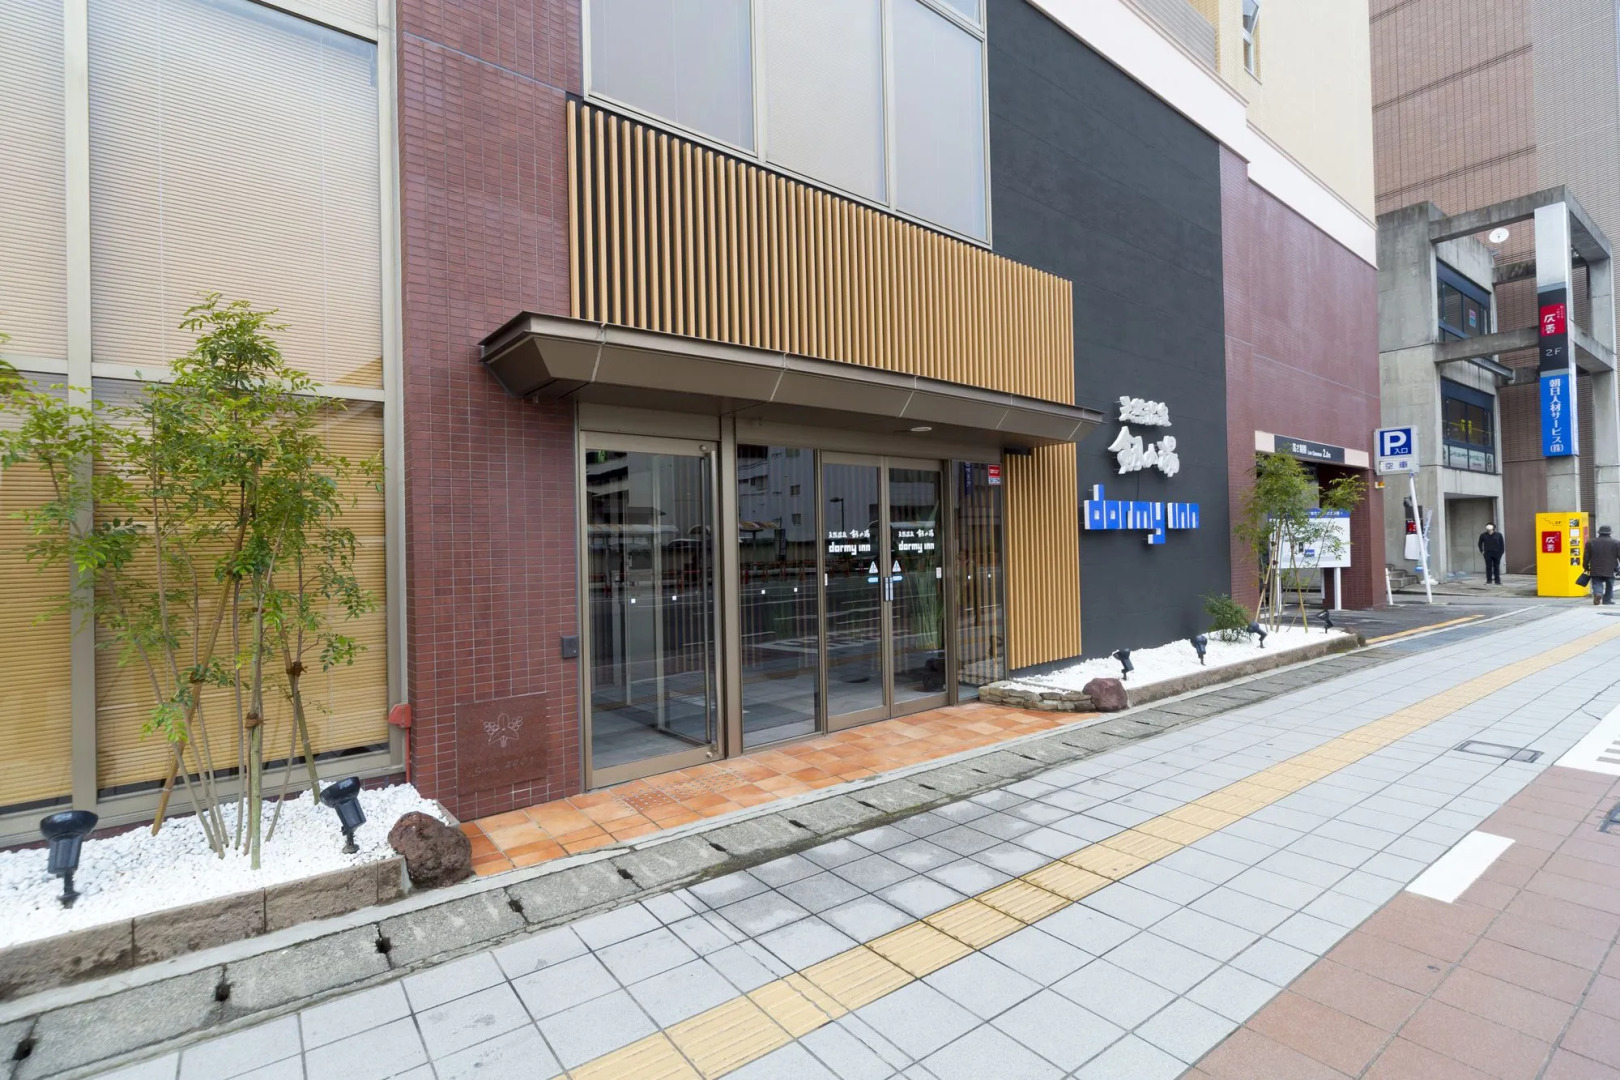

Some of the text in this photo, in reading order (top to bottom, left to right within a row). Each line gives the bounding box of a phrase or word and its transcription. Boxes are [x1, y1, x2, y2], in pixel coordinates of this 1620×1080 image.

[1545, 347, 1562, 356] 2F
[1383, 430, 1407, 456] P
[1084, 483, 1200, 544] dormy inn
[828, 541, 871, 556] dormy inn
[898, 540, 935, 554] dormy inn
